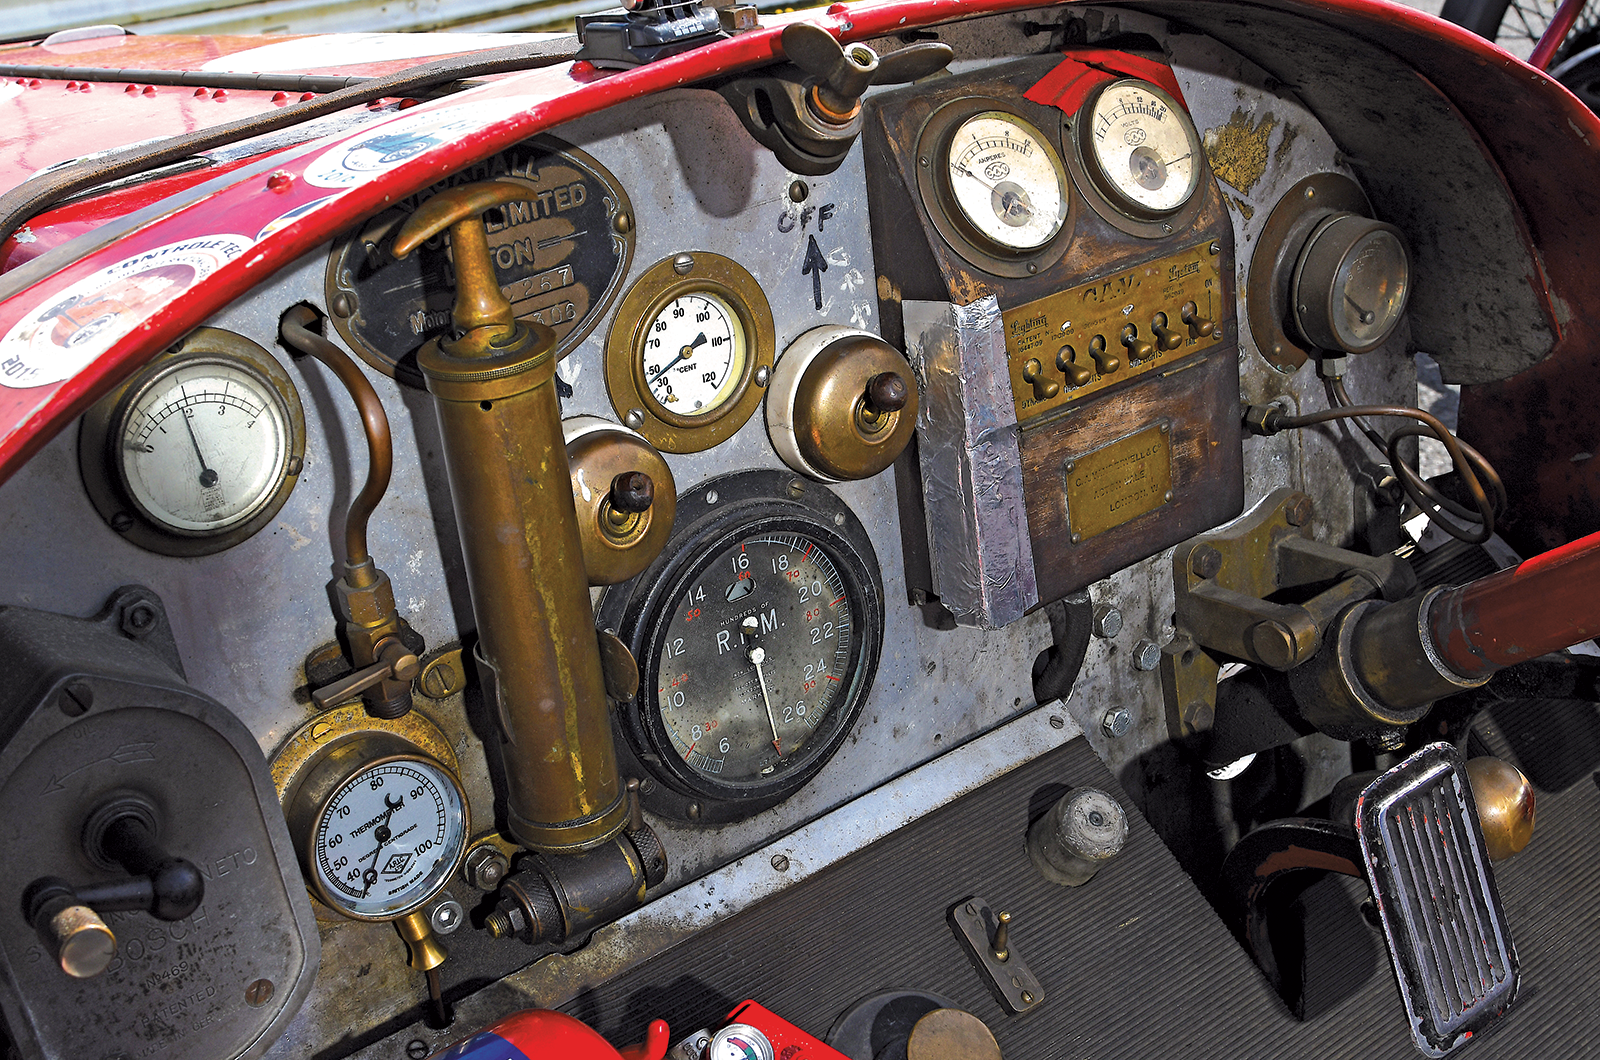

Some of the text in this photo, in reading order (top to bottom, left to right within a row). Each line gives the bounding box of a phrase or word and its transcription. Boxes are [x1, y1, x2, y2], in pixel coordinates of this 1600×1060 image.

[1120, 118, 1140, 128] VOLTS
[978, 151, 1007, 165] AMPERES
[486, 184, 587, 234] LIMITED
[777, 203, 835, 233] OFF
[1010, 261, 1201, 338] Lighting System
[673, 308, 685, 318] 90
[696, 311, 711, 323] 100
[655, 321, 667, 332] 80
[649, 338, 661, 349] 70
[711, 336, 723, 347] 110
[1017, 333, 1041, 346] PATENT
[649, 364, 661, 375] 50
[657, 377, 669, 388] 30
[702, 371, 716, 383] 120
[666, 385, 673, 395] 0
[186, 408, 195, 419] 2
[218, 405, 226, 416] 3
[159, 426, 167, 434] 1
[246, 420, 256, 429] 4
[731, 553, 750, 574] 16
[772, 555, 789, 574] 18
[738, 571, 751, 581] 60
[786, 569, 800, 582] 70
[687, 585, 706, 606] 14
[798, 581, 822, 604] 20
[685, 609, 701, 621] 50
[720, 601, 769, 627] HUNDREDS OF
[806, 608, 820, 621] 80
[716, 608, 786, 655] R..M.
[810, 622, 834, 645] 22
[666, 638, 686, 659] 12
[803, 658, 827, 681] 24
[671, 673, 688, 687] 40
[667, 691, 685, 711] 10
[782, 701, 806, 724] 26
[691, 725, 702, 742] 8
[705, 720, 718, 733] 30
[719, 738, 730, 754] 6
[369, 776, 384, 791] 80
[410, 786, 425, 800] 90
[336, 805, 351, 819] 70
[328, 833, 343, 849] 60
[358, 823, 419, 863] DEGRES CENTIGRADE
[414, 839, 433, 857] 100
[198, 846, 258, 882] NETO
[333, 856, 348, 871] 50
[346, 868, 361, 882] 40
[388, 882, 409, 896] BRITISH
[409, 870, 424, 885] MADE
[106, 905, 212, 974] BOSCH
[141, 985, 217, 1029] PATENTED
